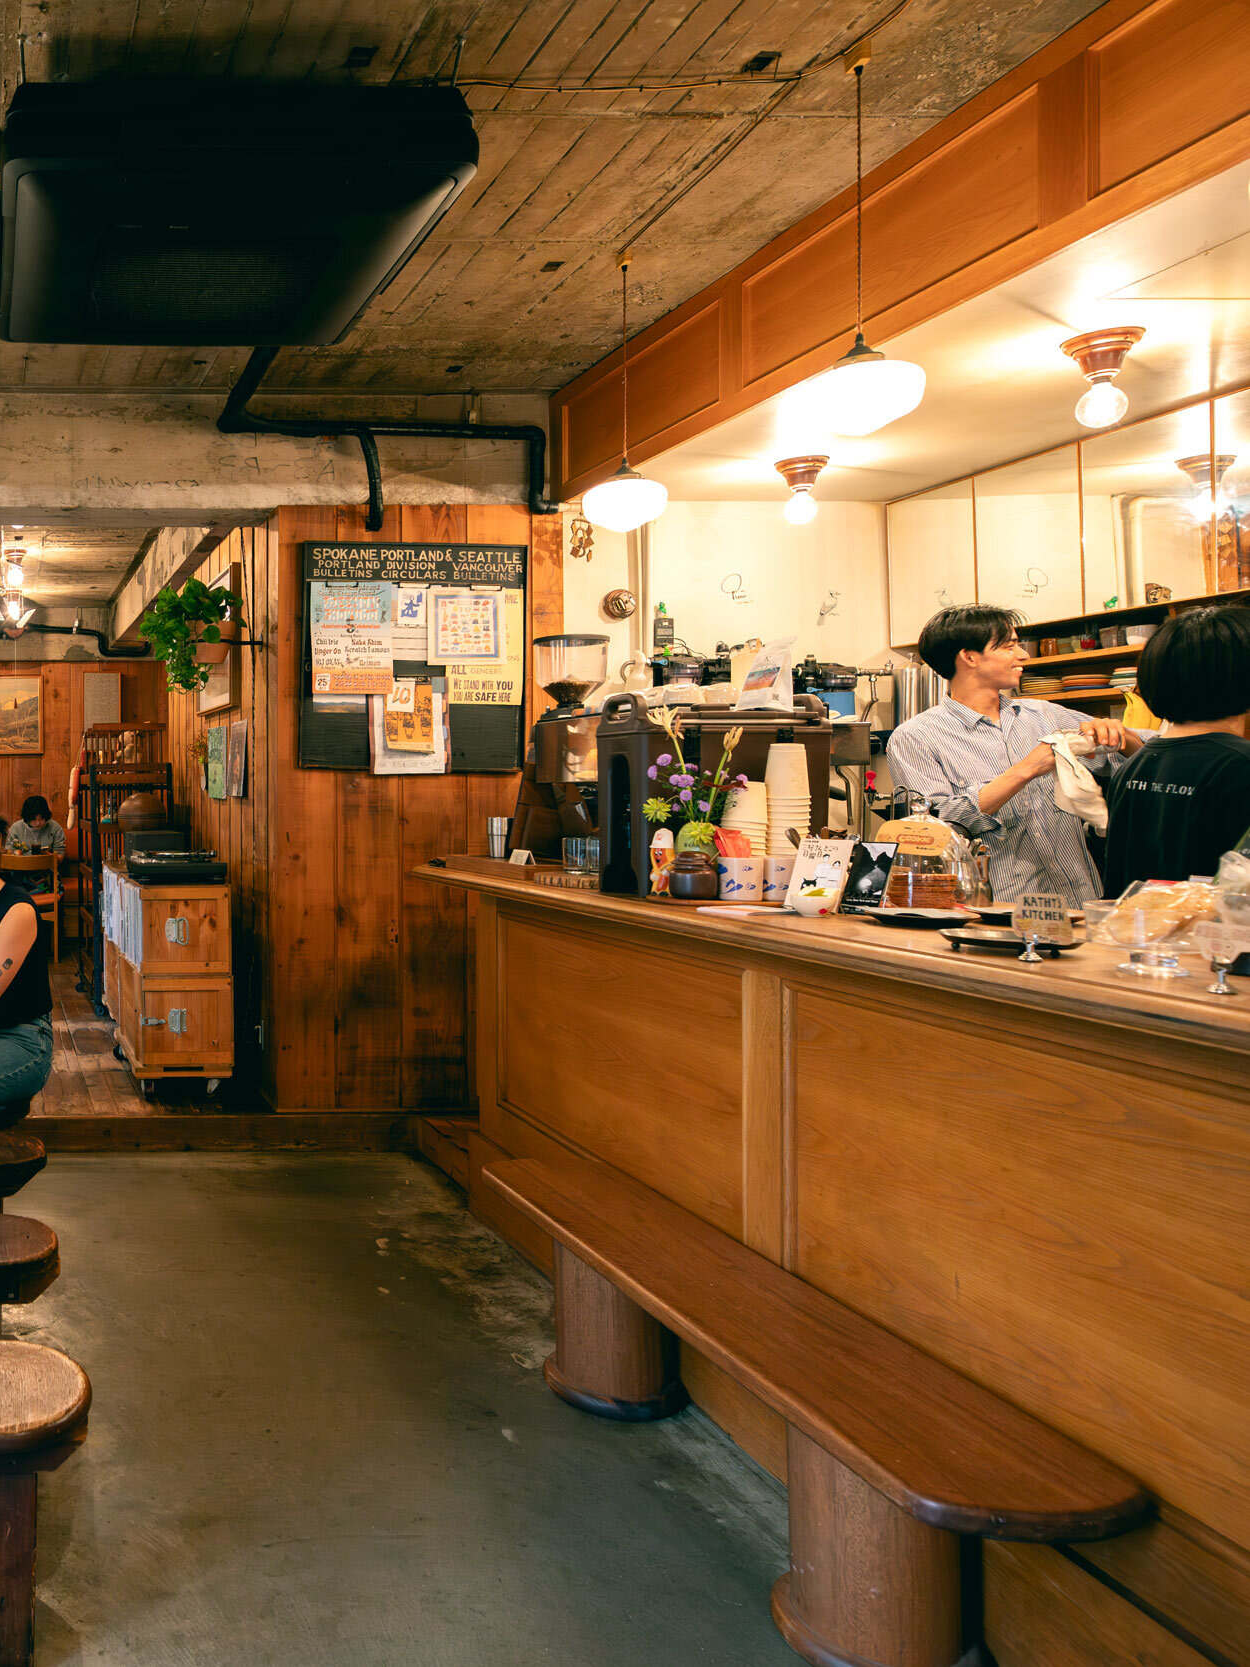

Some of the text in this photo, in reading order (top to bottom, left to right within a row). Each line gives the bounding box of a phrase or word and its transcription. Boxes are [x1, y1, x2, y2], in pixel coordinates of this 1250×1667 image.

[312, 548, 522, 564] SPOKANE PORTLAND & SEATTLE
[318, 559, 523, 574] PORTLAND DIVISION VANCOUVER
[313, 568, 516, 581] BULLETINS CIRCULARS BULLETINS
[451, 665, 467, 675] ALL
[463, 679, 480, 690] STAND
[481, 680, 494, 691] WITH
[496, 680, 514, 691] YOU
[464, 691, 475, 702] ARE
[474, 691, 498, 702] SAFE
[498, 692, 512, 703] HERE
[1022, 909, 1065, 922] KITCHEN
